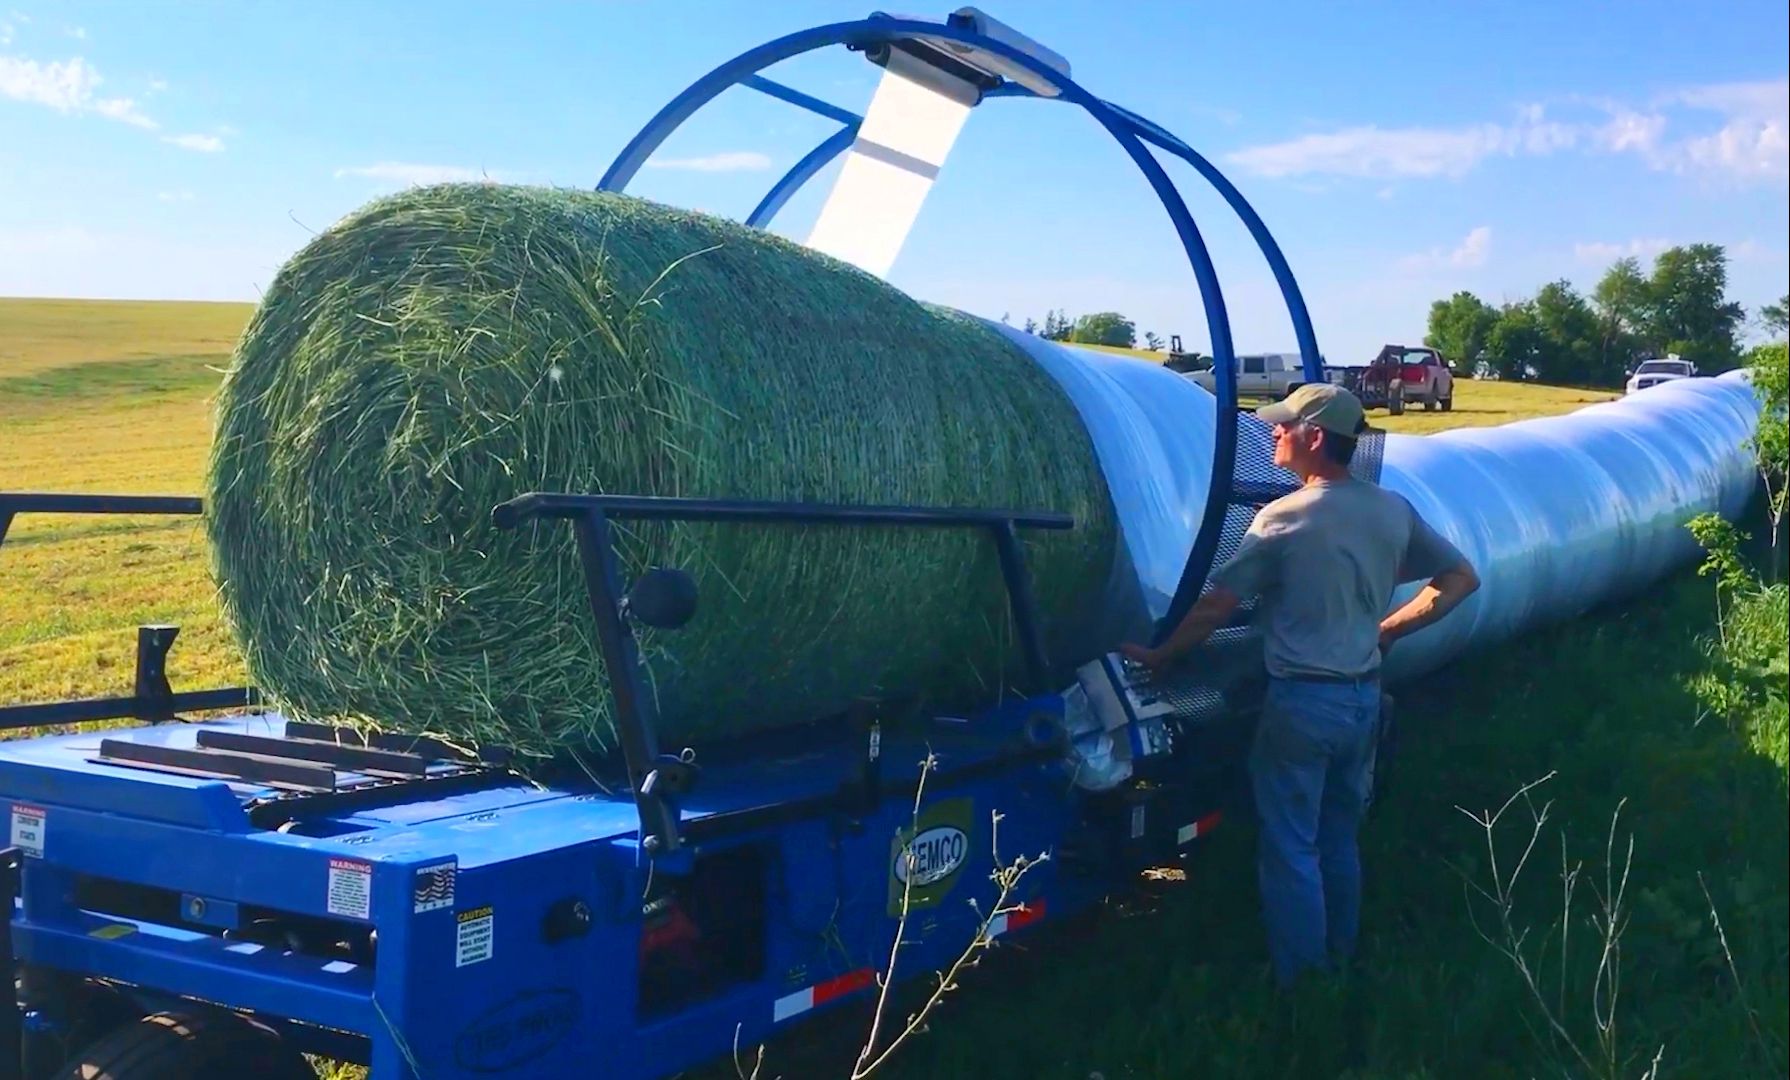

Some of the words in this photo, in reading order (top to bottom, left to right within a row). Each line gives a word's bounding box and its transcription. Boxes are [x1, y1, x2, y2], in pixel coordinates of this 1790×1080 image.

[330, 859, 371, 873] WARNING
[457, 907, 493, 922] CAUTION
[460, 918, 491, 930] AUTOMATIC
[459, 926, 491, 939] EQUIPMENT
[459, 939, 472, 948] WILL
[473, 934, 491, 944] START
